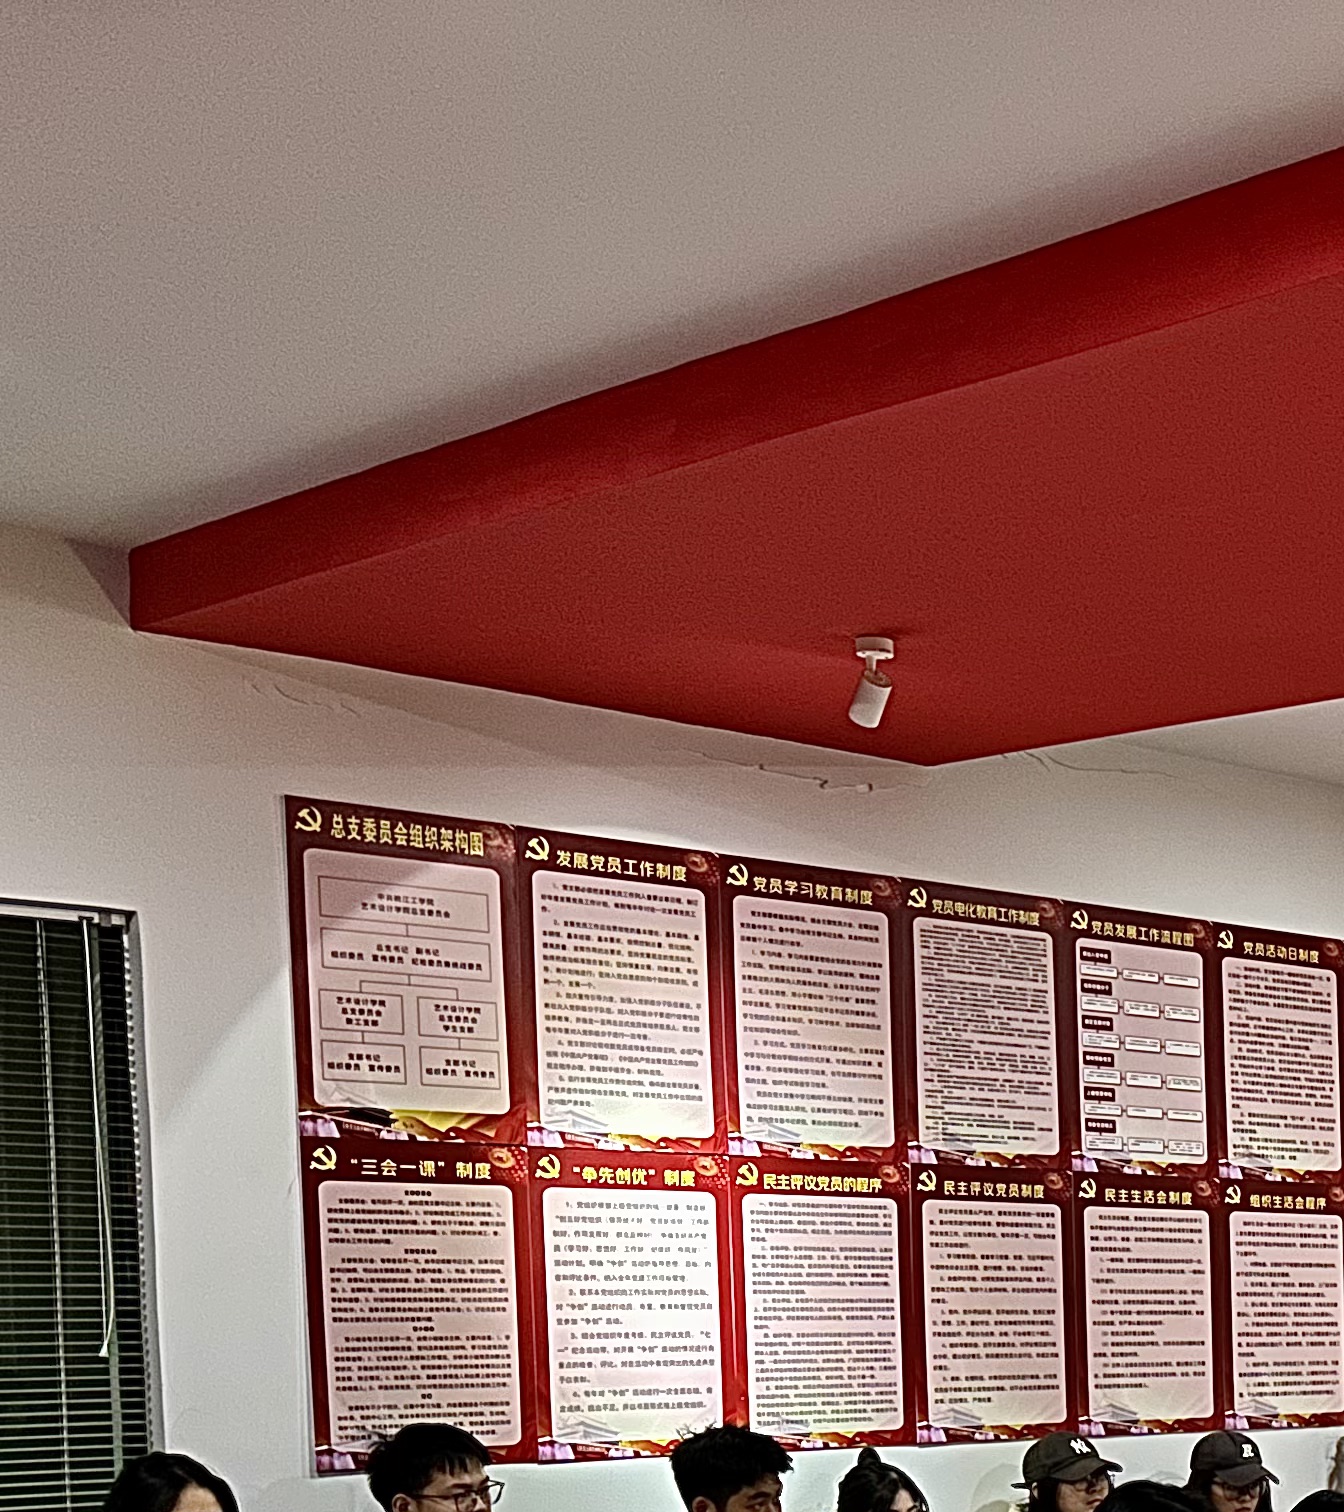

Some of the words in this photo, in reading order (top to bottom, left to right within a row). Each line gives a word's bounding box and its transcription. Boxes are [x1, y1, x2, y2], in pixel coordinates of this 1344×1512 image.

[330, 813, 485, 857] 总支委员会组织架构图
[556, 850, 687, 882] 发展党员工作制度
[753, 876, 873, 906] 党员学习教育制度
[932, 899, 1040, 927] 党员电化教育工作制度
[1091, 921, 1195, 948] 党员发展工作流程图
[1243, 942, 1319, 964] 党员活动日制度
[763, 1173, 883, 1194] 民主评议党员的程序
[944, 1180, 1045, 1199] 民主评议党员制度
[1104, 1188, 1193, 1206] 民主生活会制度
[1249, 1194, 1327, 1211] 组织生活会程序
